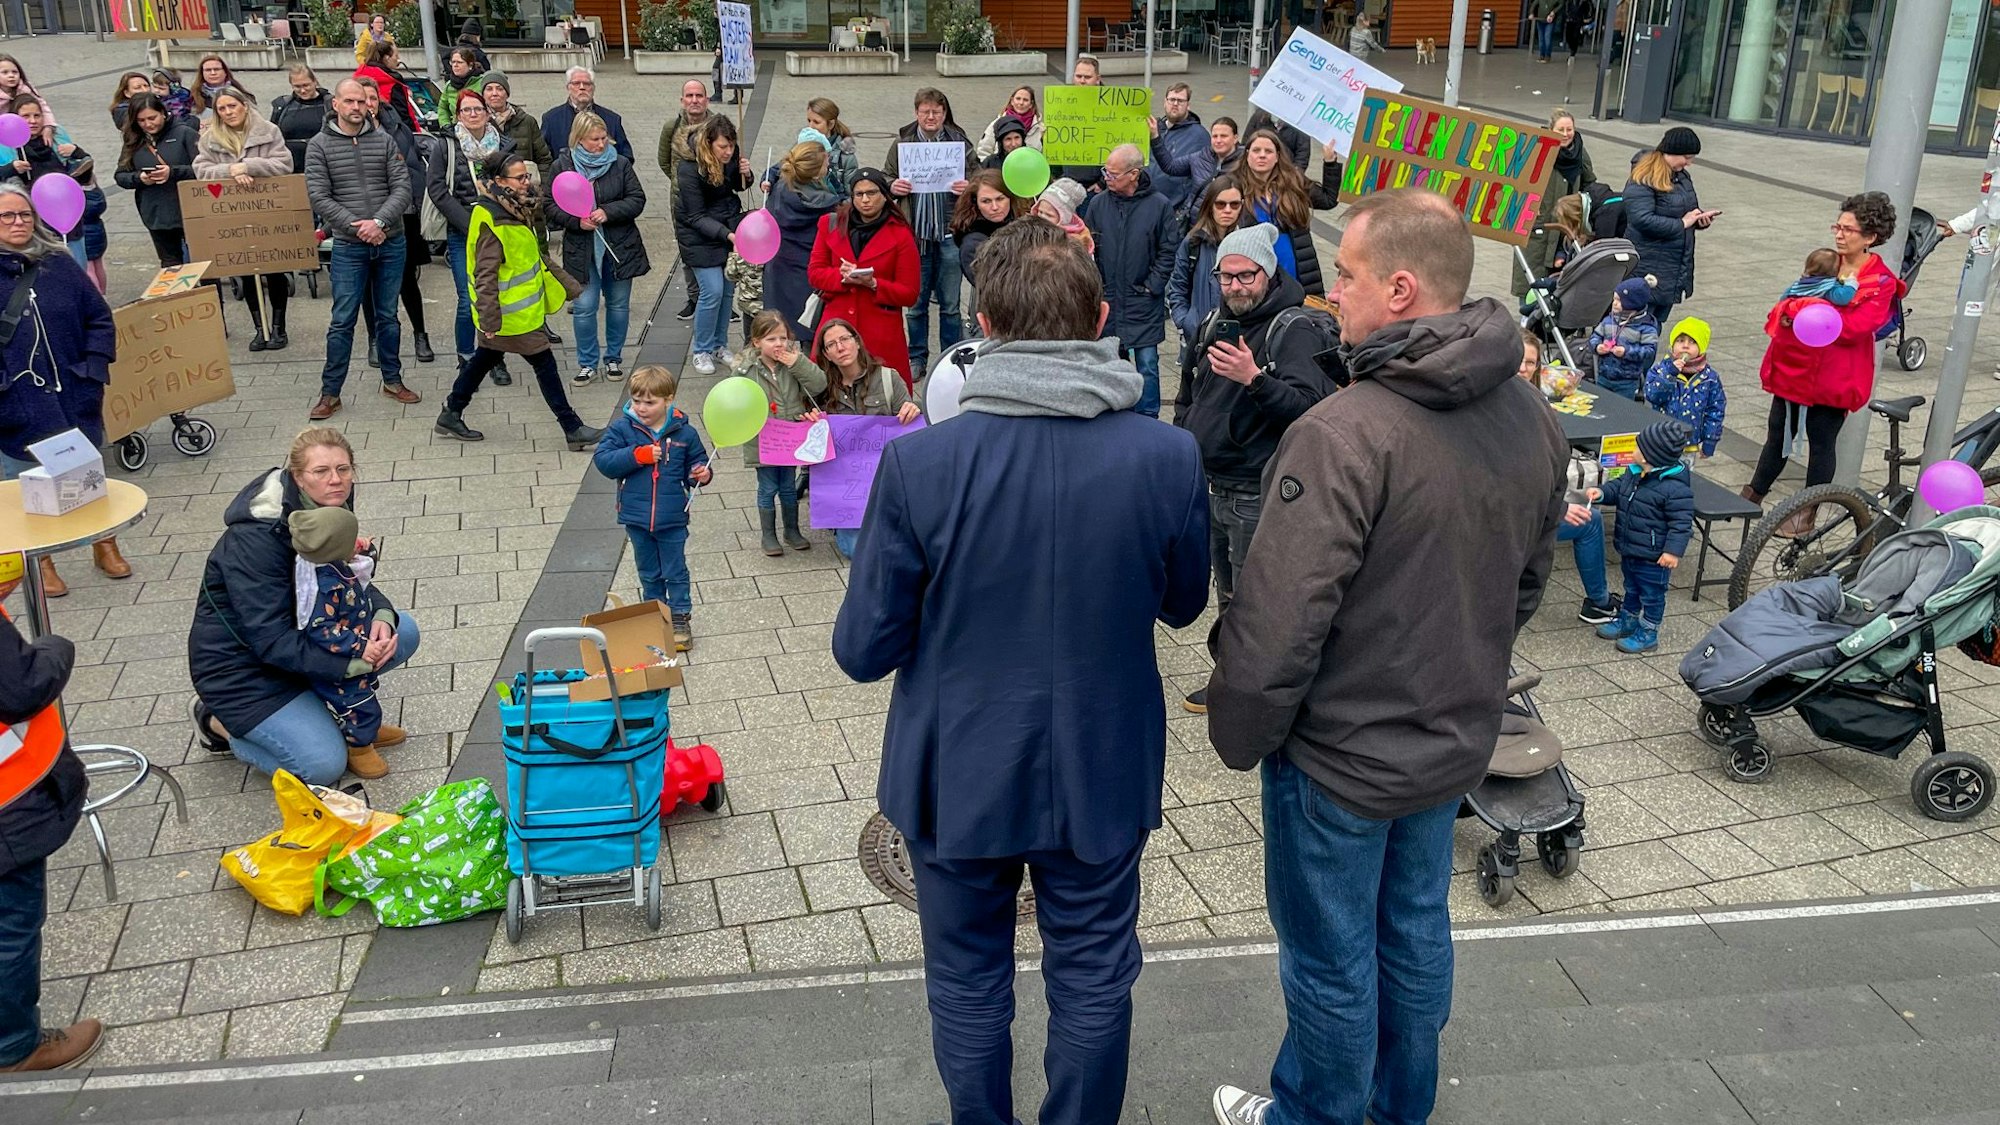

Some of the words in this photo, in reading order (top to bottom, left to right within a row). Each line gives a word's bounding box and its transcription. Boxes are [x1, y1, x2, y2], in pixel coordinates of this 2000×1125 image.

[1288, 39, 1327, 71] Genug
[1325, 63, 1342, 76] der
[1339, 67, 1368, 93] Ausr
[1046, 90, 1061, 104] Um
[1098, 87, 1147, 106] KIND
[1275, 79, 1295, 96] Zeit
[1293, 91, 1306, 102] zu
[1310, 95, 1355, 135] hande
[1046, 125, 1096, 144] DORF.
[1105, 132, 1126, 145] Doch
[1363, 96, 1460, 160] TEILEN
[1455, 120, 1561, 184] LERNT
[191, 187, 209, 198] DIE
[223, 184, 241, 196] DER
[1342, 150, 1394, 196] MAN
[1392, 161, 1462, 197] NICHT
[1453, 176, 1541, 237] ALLEINE
[273, 223, 301, 235] MEHR
[154, 302, 216, 333] SIND
[134, 345, 183, 374] DER
[109, 359, 225, 421] ANFANG
[833, 425, 887, 453] Kind
[850, 460, 873, 474] sin
[1922, 651, 1936, 673] Joie
